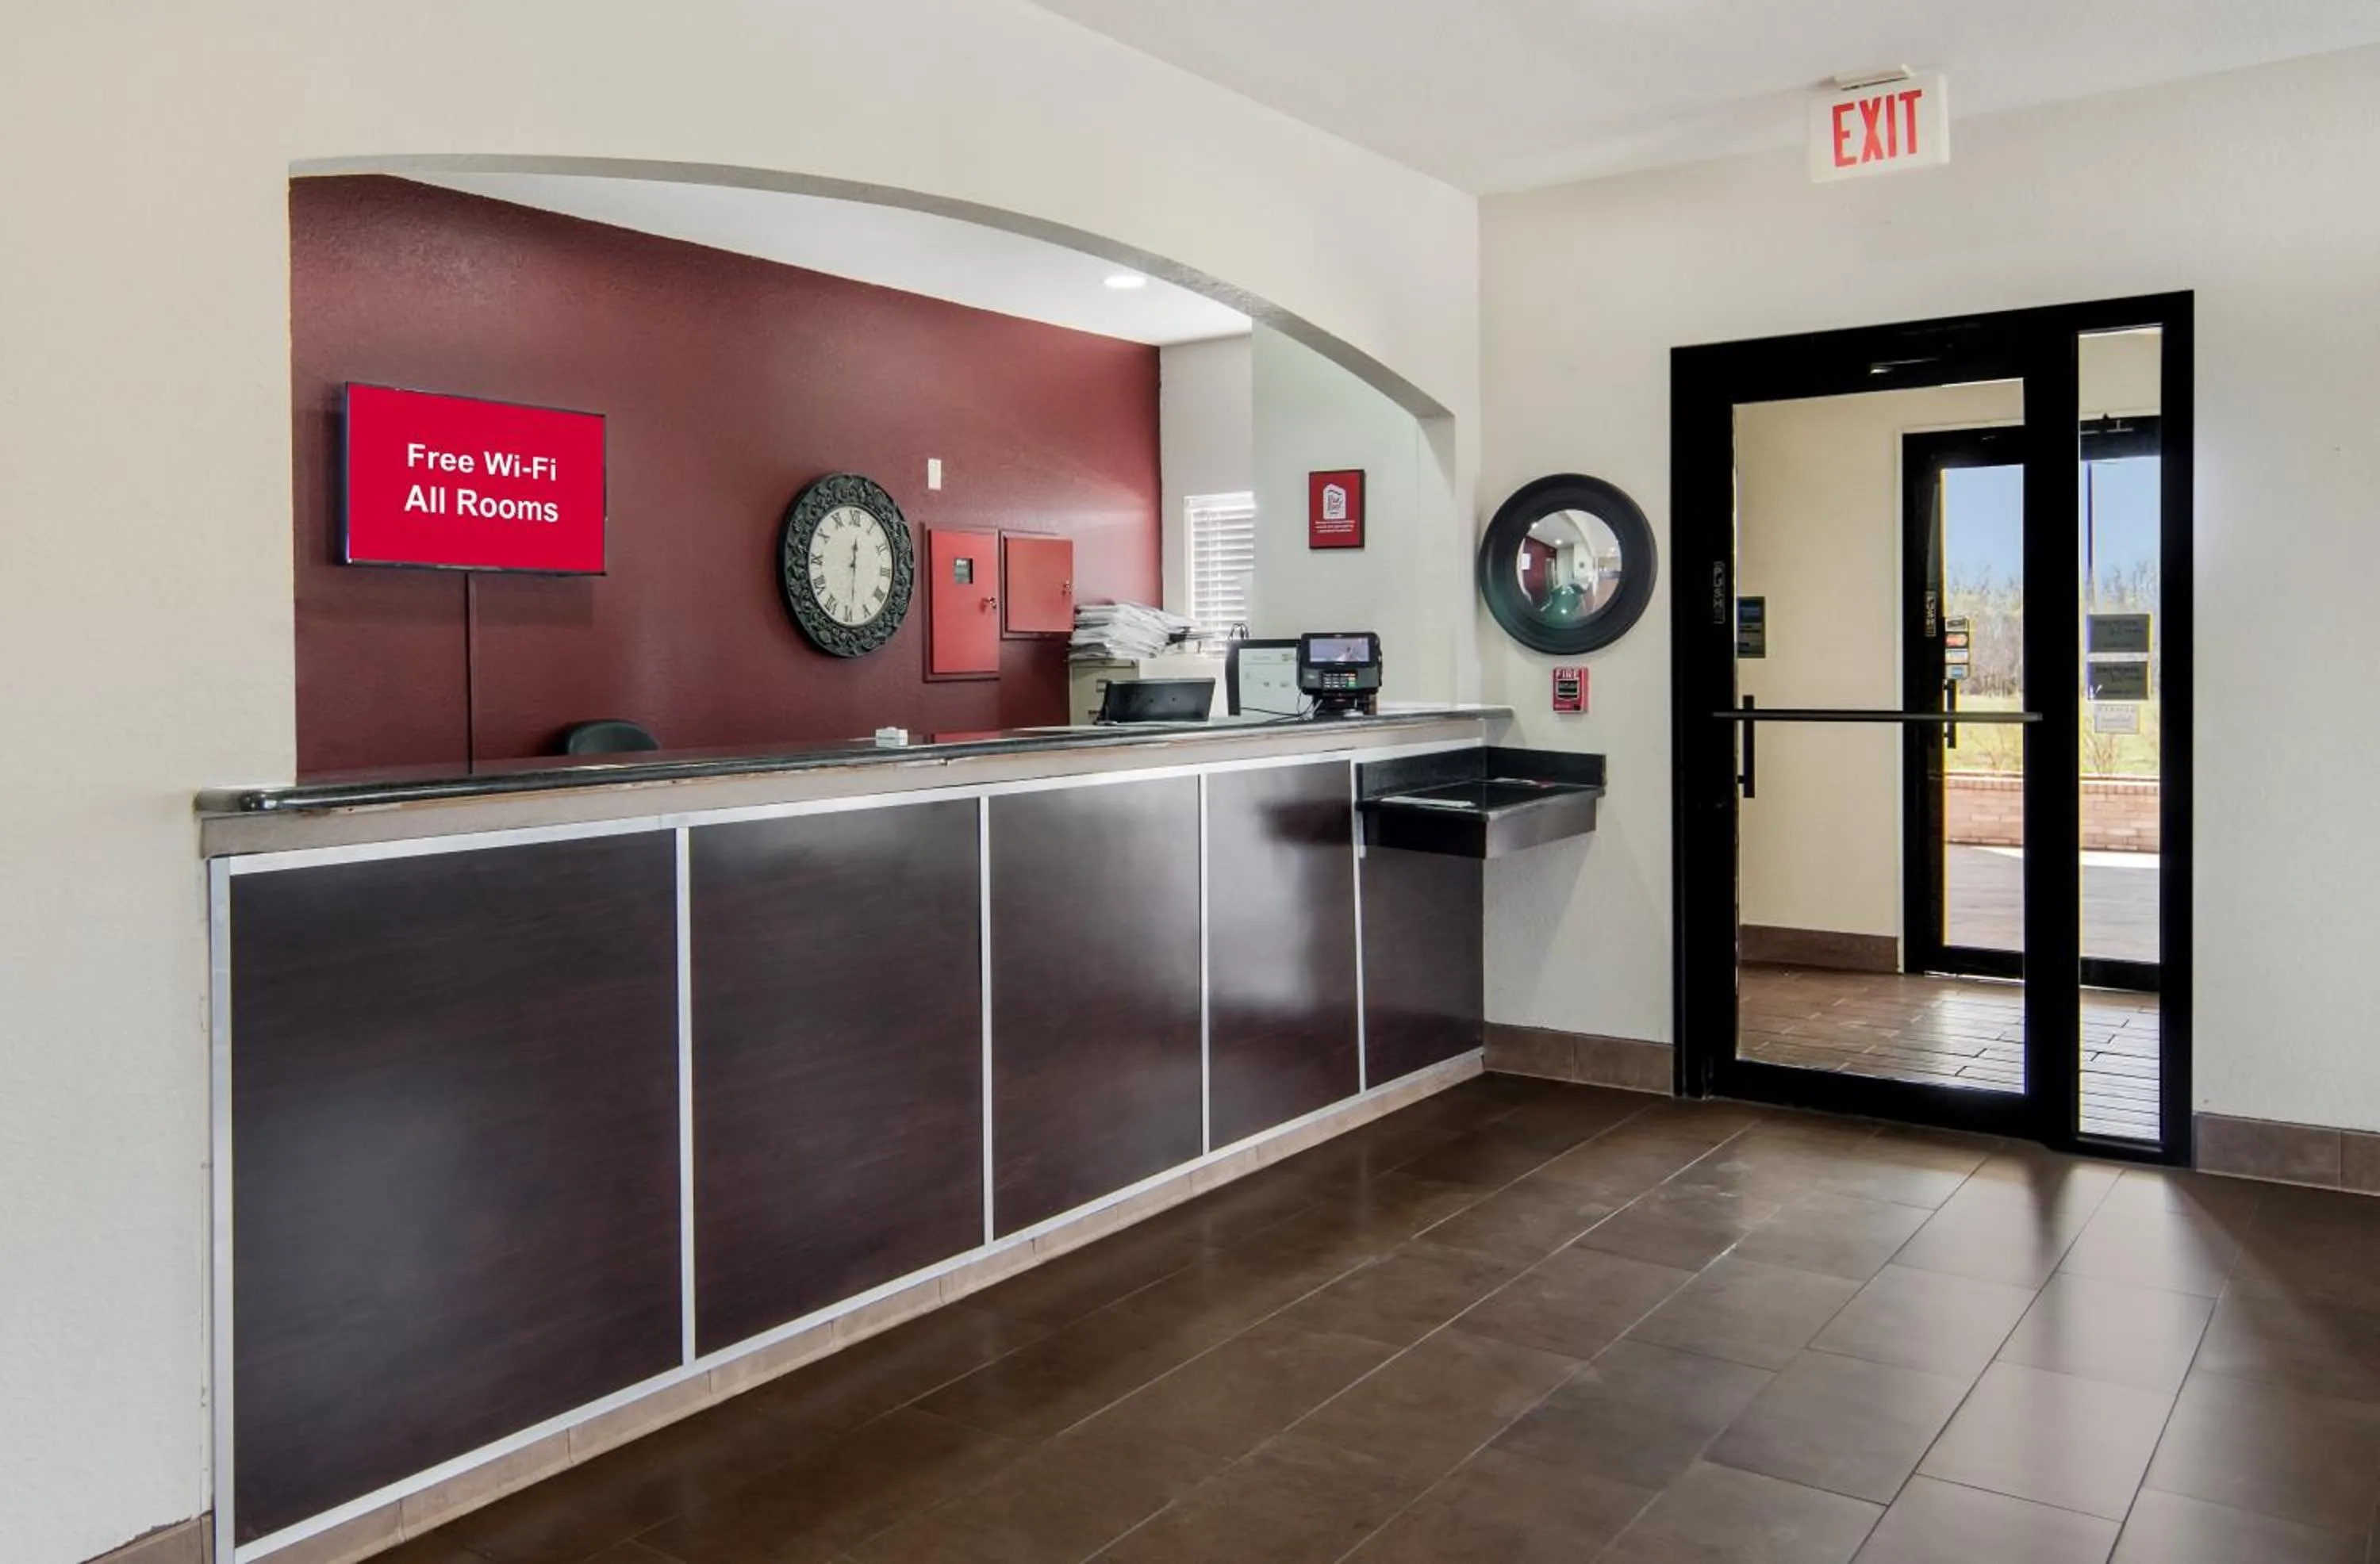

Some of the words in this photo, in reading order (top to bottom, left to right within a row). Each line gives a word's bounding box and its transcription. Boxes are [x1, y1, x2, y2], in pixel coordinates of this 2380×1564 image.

[1832, 88, 1922, 167] EXIT
[406, 443, 475, 473] Free
[483, 450, 557, 481] Wi-Fi
[404, 484, 445, 515] All
[457, 487, 559, 523] Rooms
[1556, 668, 1580, 679] FIRE
